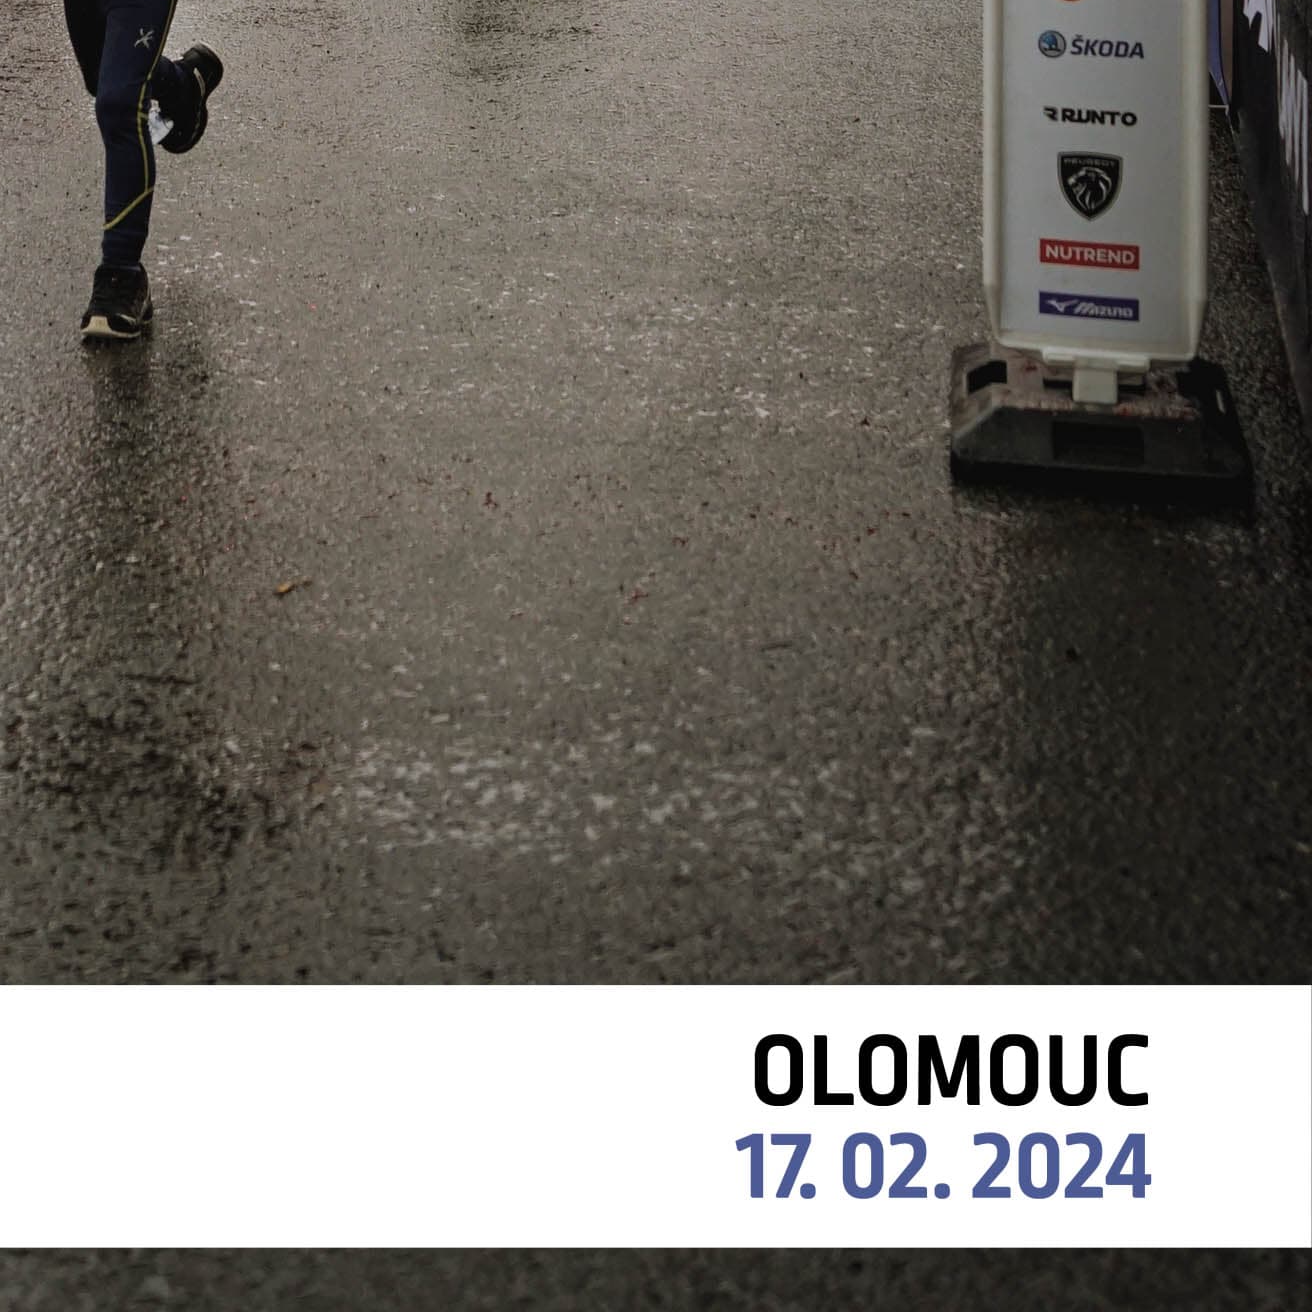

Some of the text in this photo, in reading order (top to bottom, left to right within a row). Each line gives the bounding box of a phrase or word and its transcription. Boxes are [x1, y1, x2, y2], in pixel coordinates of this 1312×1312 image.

[1070, 34, 1145, 60] ŠKODA
[1061, 108, 1138, 127] RUNTO
[1045, 244, 1136, 266] NUTREND
